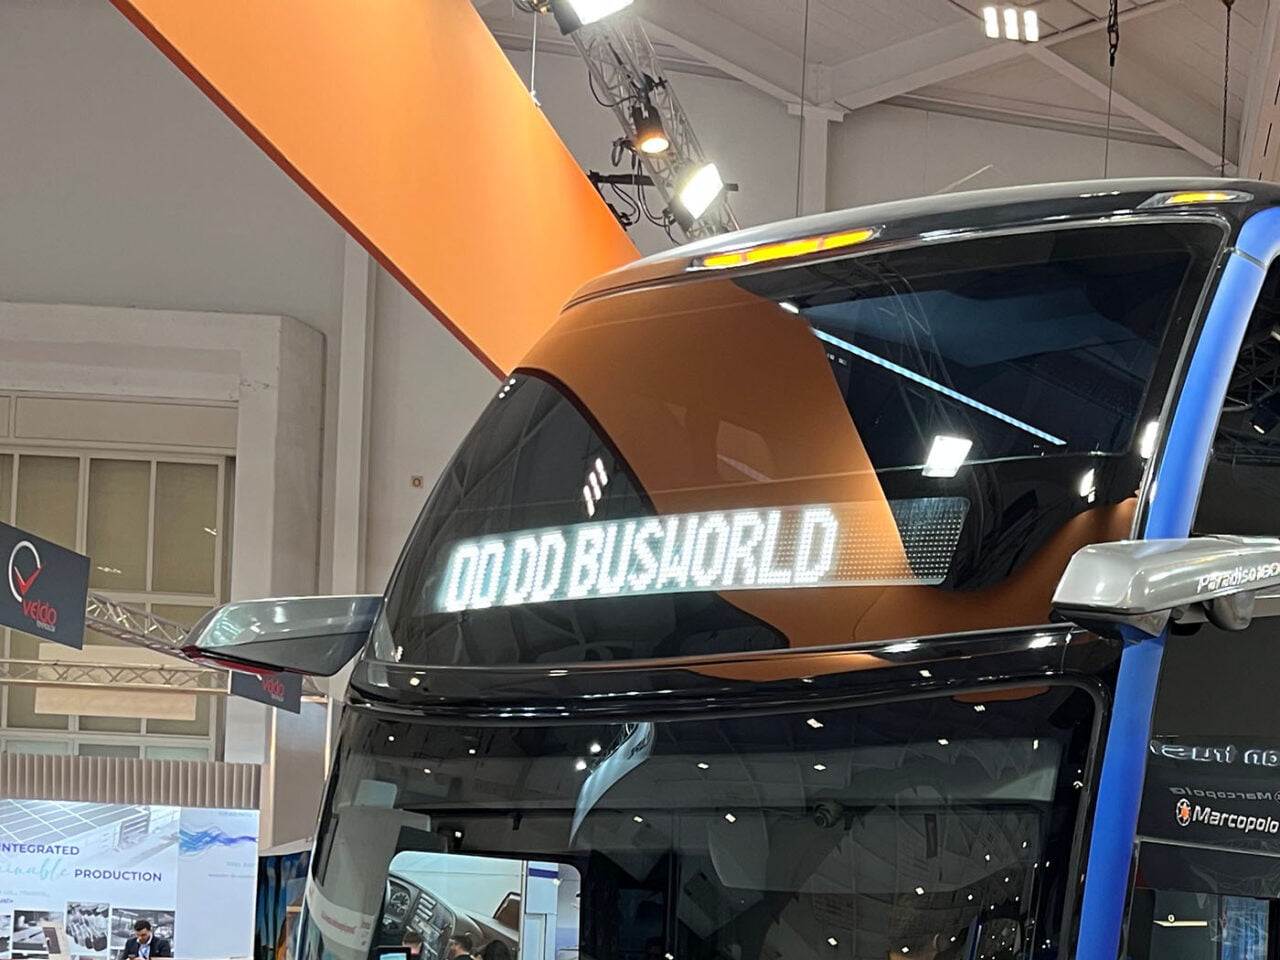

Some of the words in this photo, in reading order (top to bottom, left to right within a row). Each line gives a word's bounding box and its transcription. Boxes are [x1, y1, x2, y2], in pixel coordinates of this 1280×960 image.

[567, 507, 839, 598] BUSWORLD
[1192, 804, 1280, 835] Marcopolo
[1, 842, 80, 856] NTEGRATED
[74, 868, 162, 882] PRODUCTION
